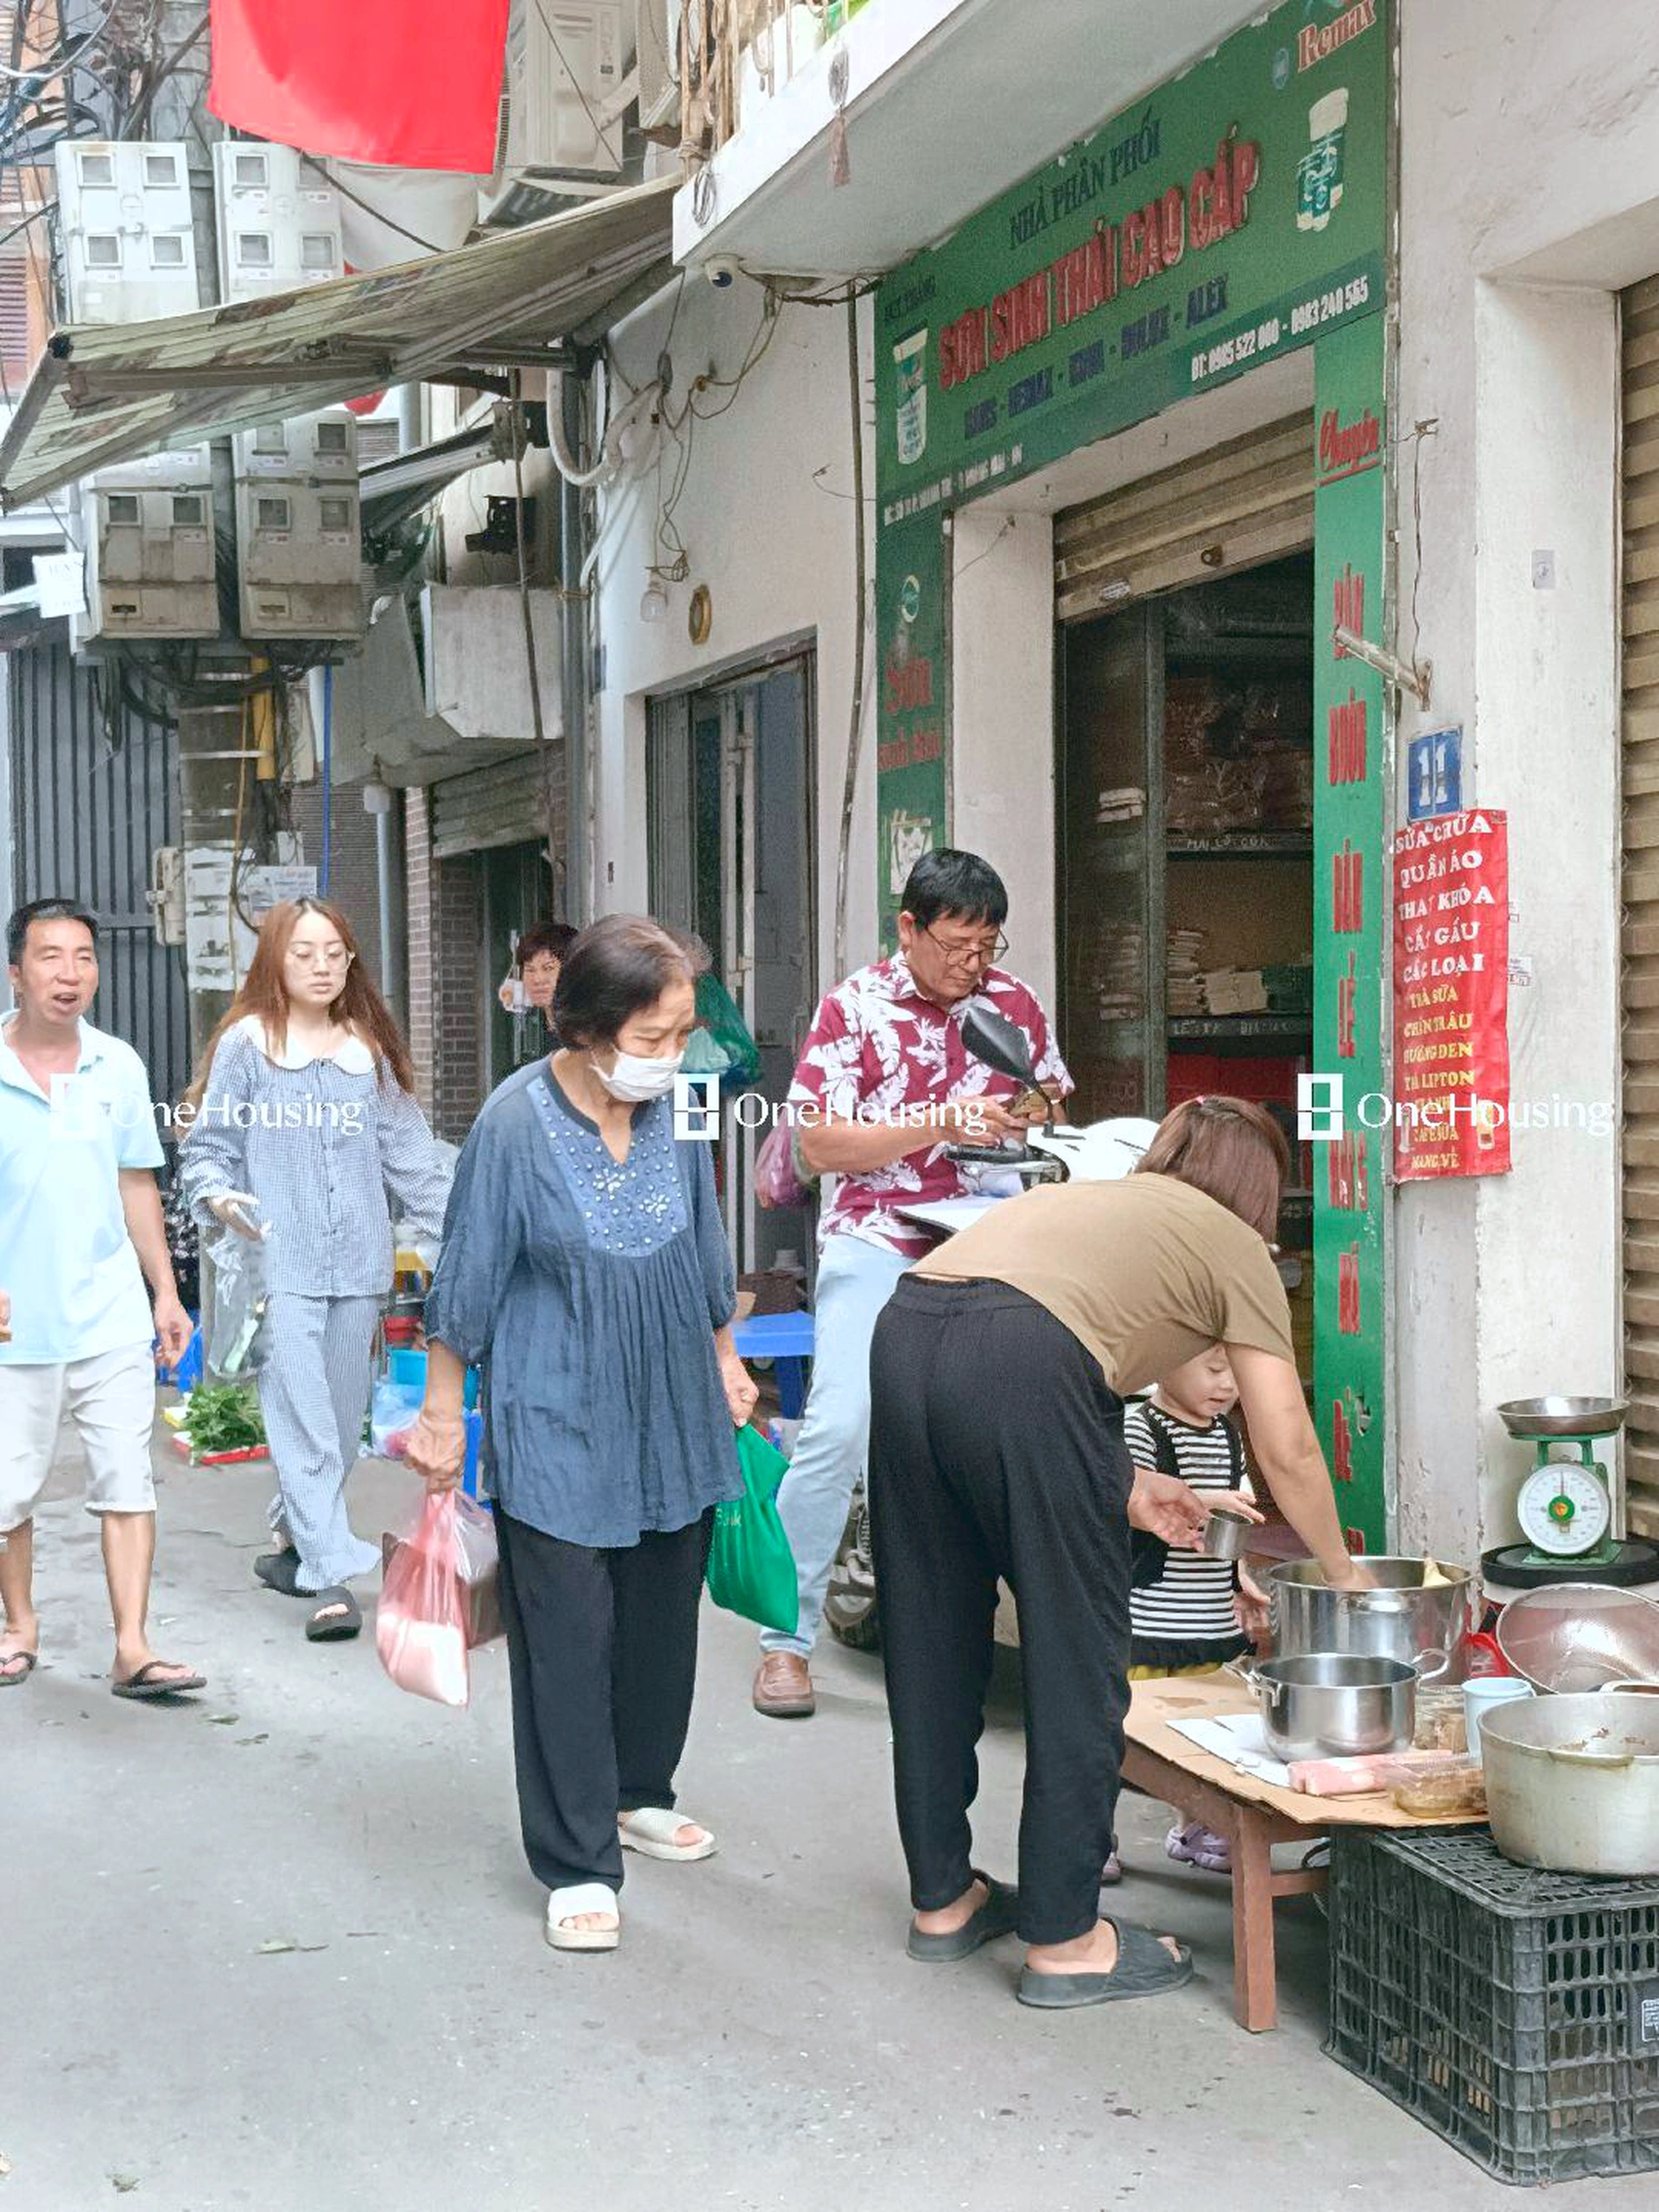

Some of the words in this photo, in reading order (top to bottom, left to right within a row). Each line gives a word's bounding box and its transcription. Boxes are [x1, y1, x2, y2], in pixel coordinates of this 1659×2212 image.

[991, 270, 1052, 364] SINH
[1120, 185, 1185, 288] CAO
[1188, 122, 1261, 251] CẤP
[1418, 743, 1448, 807] 11
[1400, 853, 1447, 889] QUẦN
[1449, 849, 1484, 874] ÁO
[1437, 882, 1496, 912] KHÓA
[1434, 916, 1482, 946] GẤU
[1431, 953, 1485, 979] LOẠI
[1421, 1069, 1476, 1089] LIPTON
